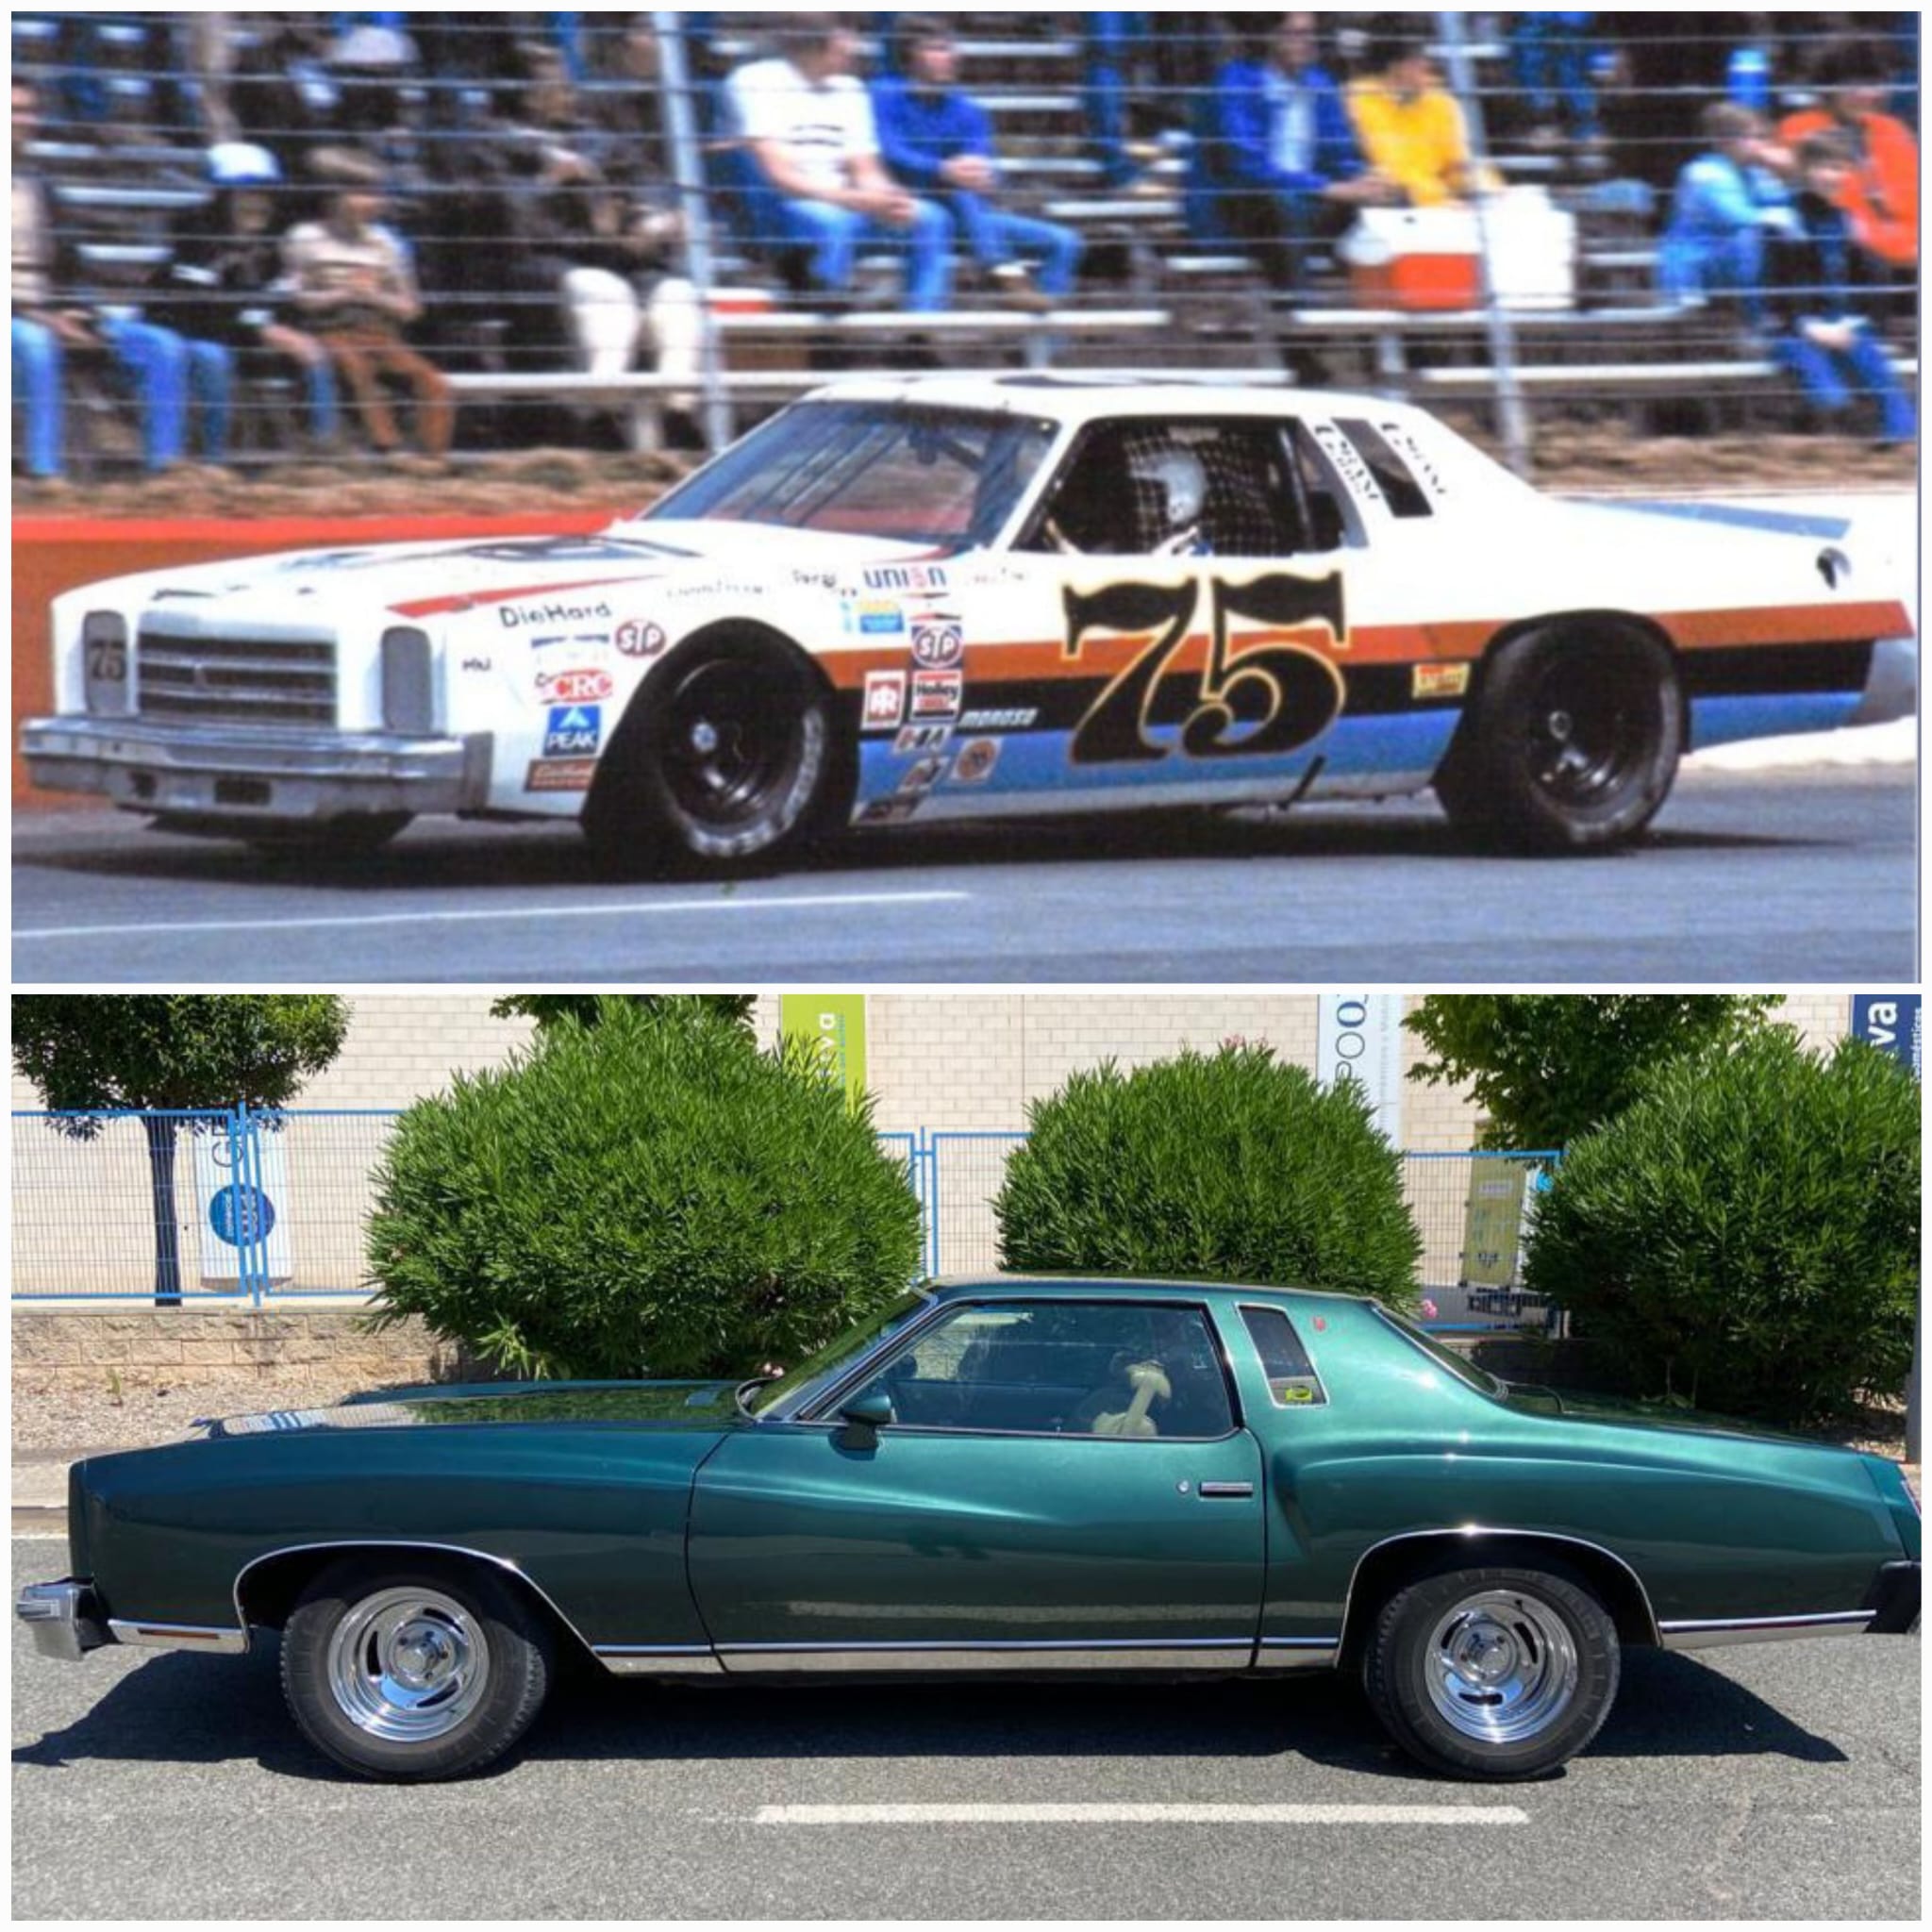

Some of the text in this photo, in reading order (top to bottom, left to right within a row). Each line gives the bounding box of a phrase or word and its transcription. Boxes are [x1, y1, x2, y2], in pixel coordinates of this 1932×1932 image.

[616, 619, 664, 656] STP
[917, 625, 959, 662] STP
[1061, 569, 1351, 765] 75
[554, 674, 613, 698] CRC
[547, 730, 597, 749] PEAK
